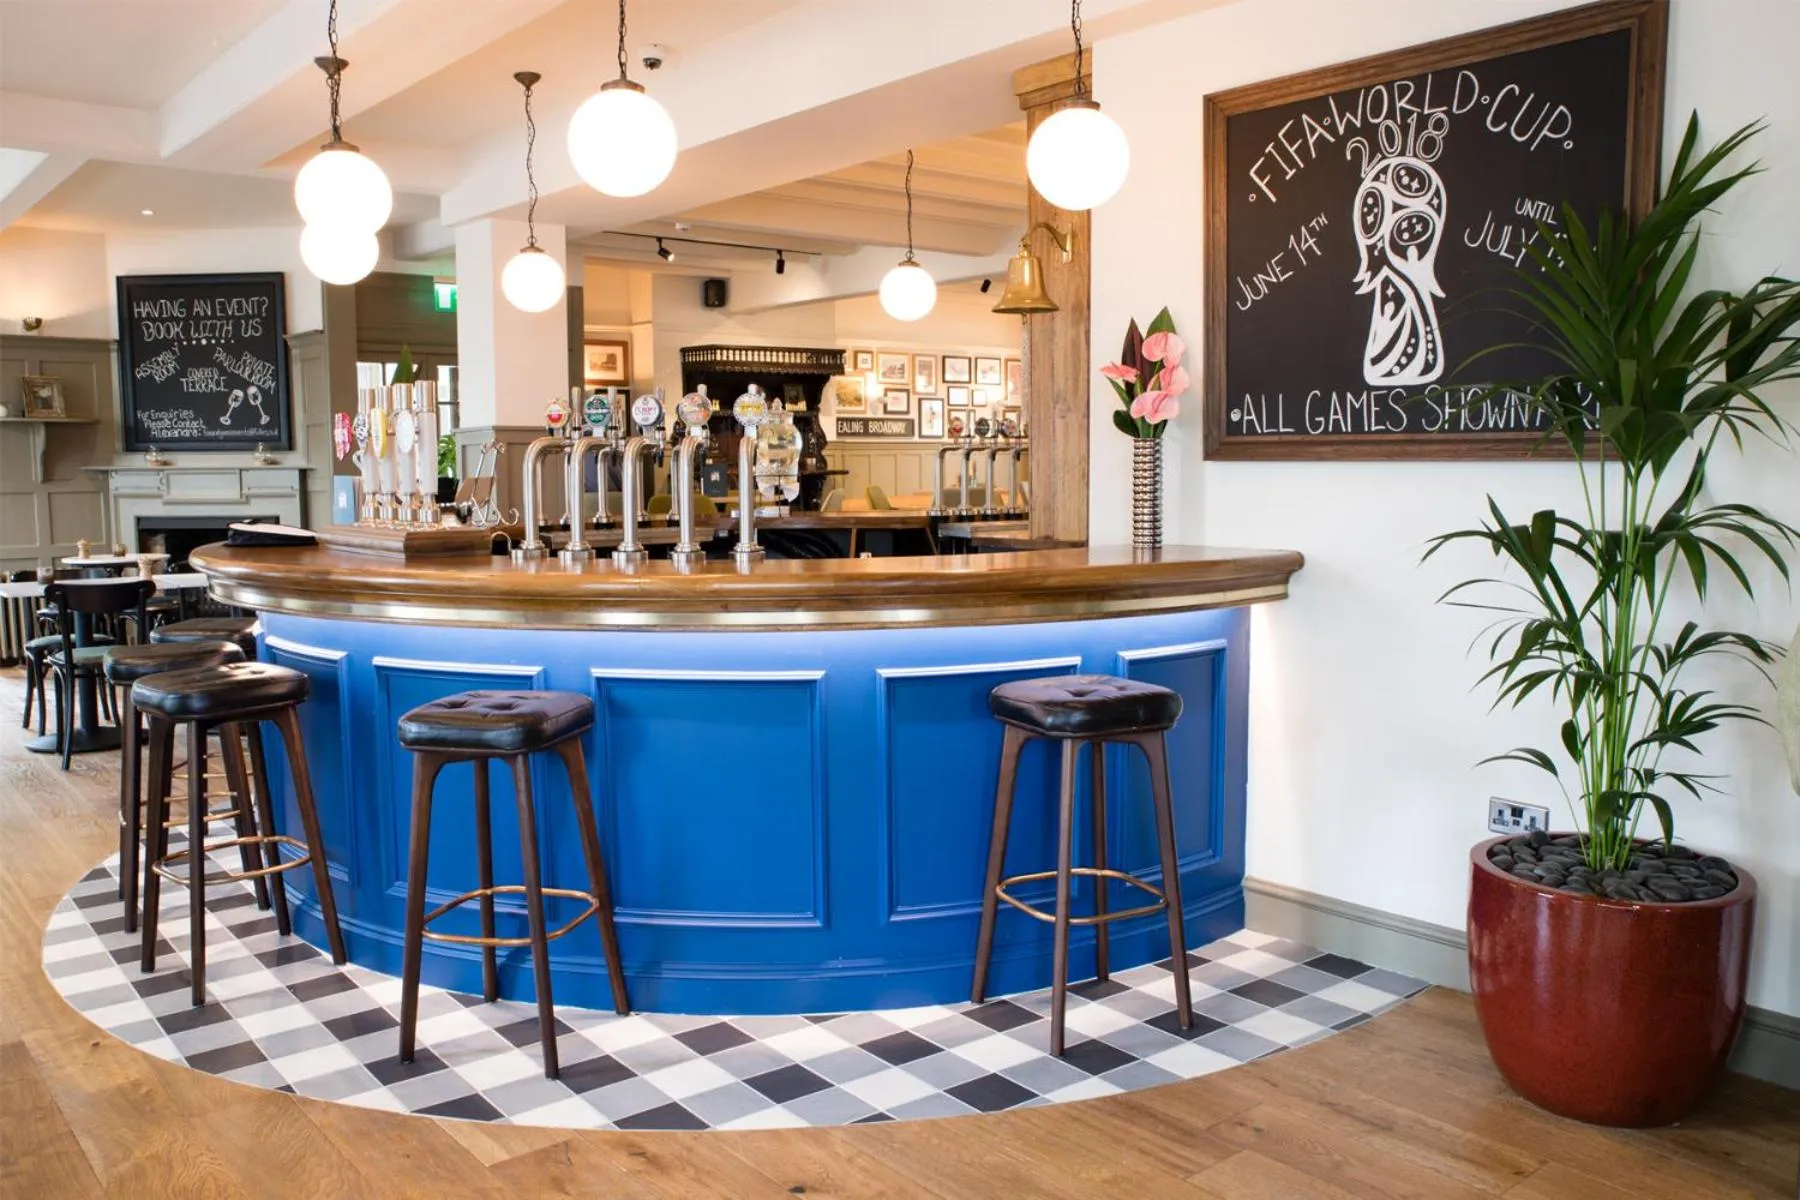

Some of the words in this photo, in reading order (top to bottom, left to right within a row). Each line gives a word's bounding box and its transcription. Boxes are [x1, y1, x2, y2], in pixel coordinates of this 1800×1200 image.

[1249, 113, 1336, 203] FIFA
[1328, 70, 1480, 136] WORLD
[1346, 111, 1450, 179] 2018
[1514, 197, 1558, 225] UNTIL
[1463, 210, 1540, 268] JULY
[1235, 251, 1295, 311] JUNE
[1288, 212, 1329, 267] 14TH
[133, 298, 187, 318] HAVING
[193, 298, 212, 317] AN
[215, 296, 269, 318] EVENT?
[141, 320, 185, 341] BOOK
[189, 319, 233, 338] WITH
[241, 318, 263, 338] US
[134, 341, 181, 380] ASSEMBLY
[151, 360, 181, 384] ROOM
[186, 367, 220, 380] COVERED
[240, 351, 276, 380] PRIVATE
[180, 375, 229, 393] TERRACE
[1242, 392, 1296, 435] ALL
[1304, 387, 1408, 435] GAMES
[1421, 384, 1530, 432] SHOWN
[837, 420, 864, 433] EALING
[868, 420, 908, 433] BROADWAY
